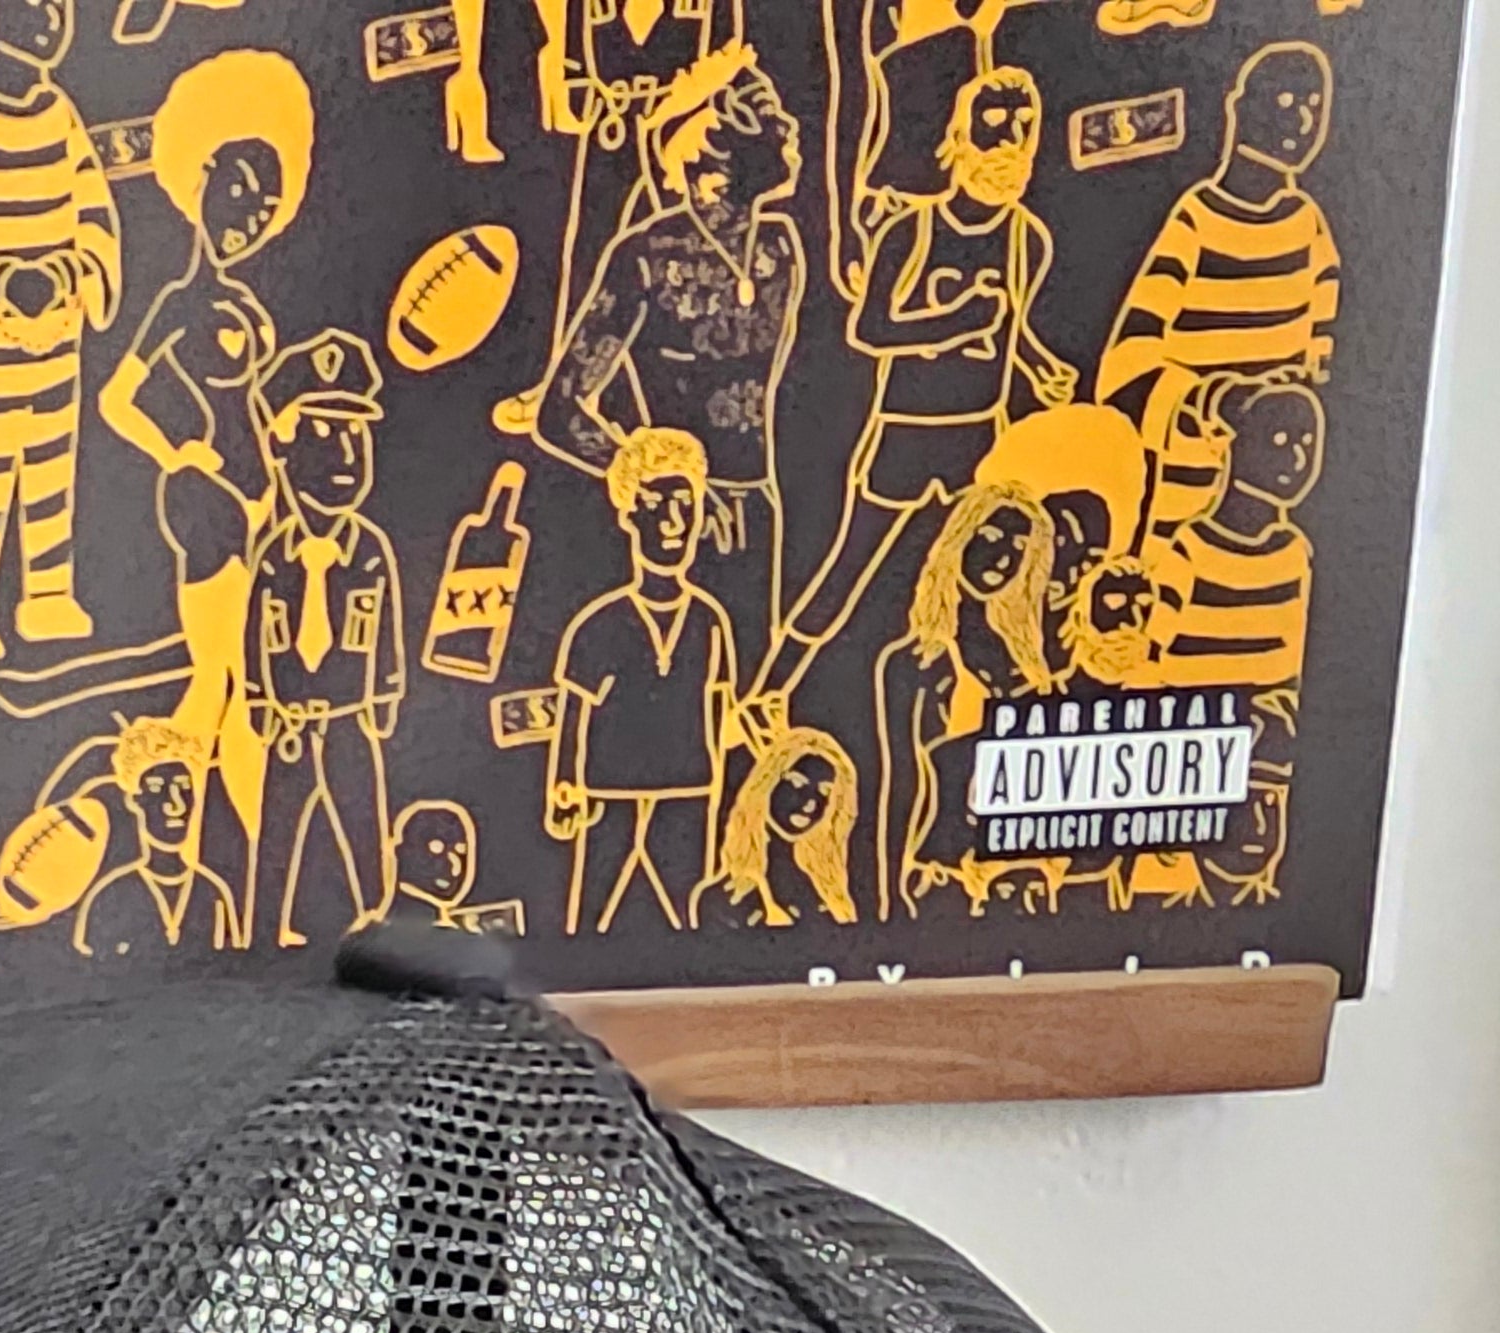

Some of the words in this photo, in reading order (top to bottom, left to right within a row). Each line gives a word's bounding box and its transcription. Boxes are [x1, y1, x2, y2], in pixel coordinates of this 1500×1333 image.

[994, 692, 1237, 738] PARENTAL
[988, 735, 1237, 805] ADVISORY
[987, 813, 1103, 853] EXPLICIT
[1111, 807, 1229, 847] CONTENT
